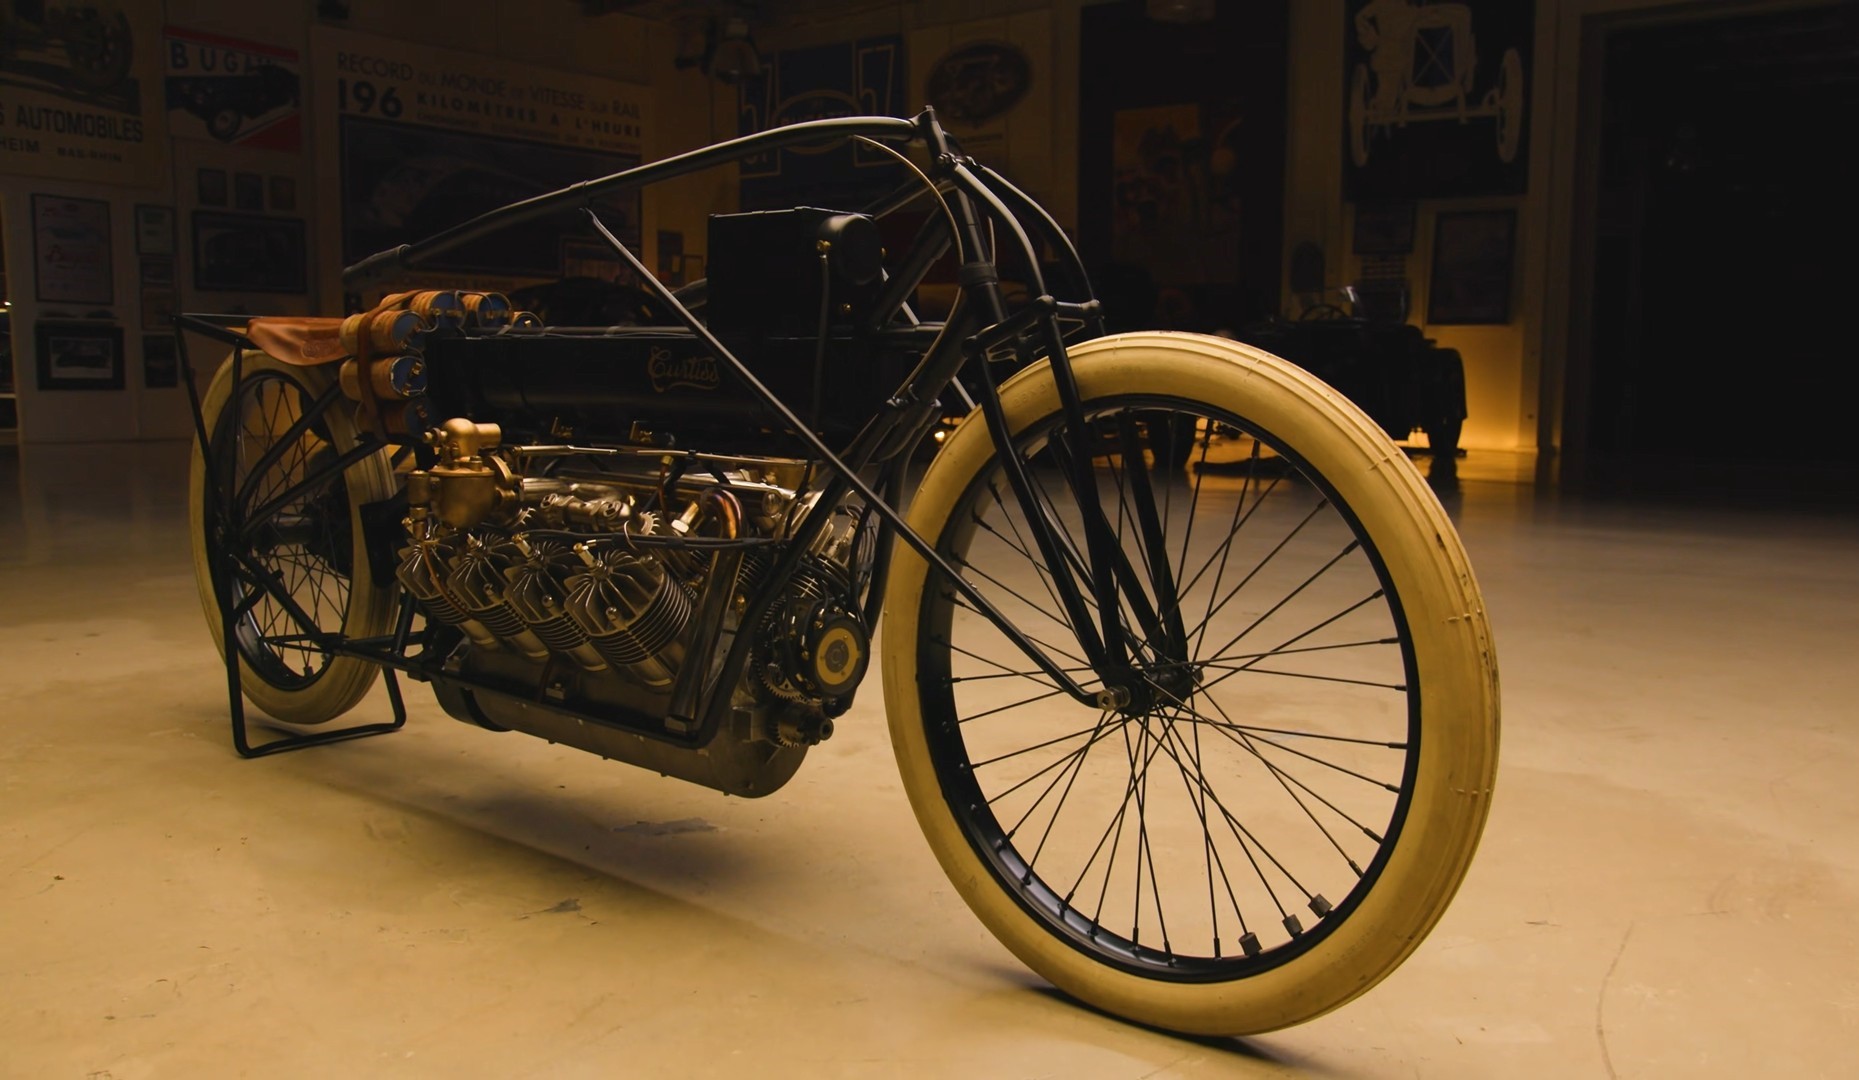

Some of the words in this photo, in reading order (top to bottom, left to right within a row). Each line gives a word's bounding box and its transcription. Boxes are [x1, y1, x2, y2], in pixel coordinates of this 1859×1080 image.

[170, 39, 272, 76] BUGA
[337, 51, 414, 81] RECORD
[441, 72, 506, 97] MONDE
[529, 85, 585, 111] VITESSE
[612, 99, 640, 120] RAIL
[337, 78, 403, 118] 196
[16, 103, 143, 143] AUTOMOBILES
[575, 117, 640, 138] L'HEURE
[647, 345, 720, 392] Curtiss
